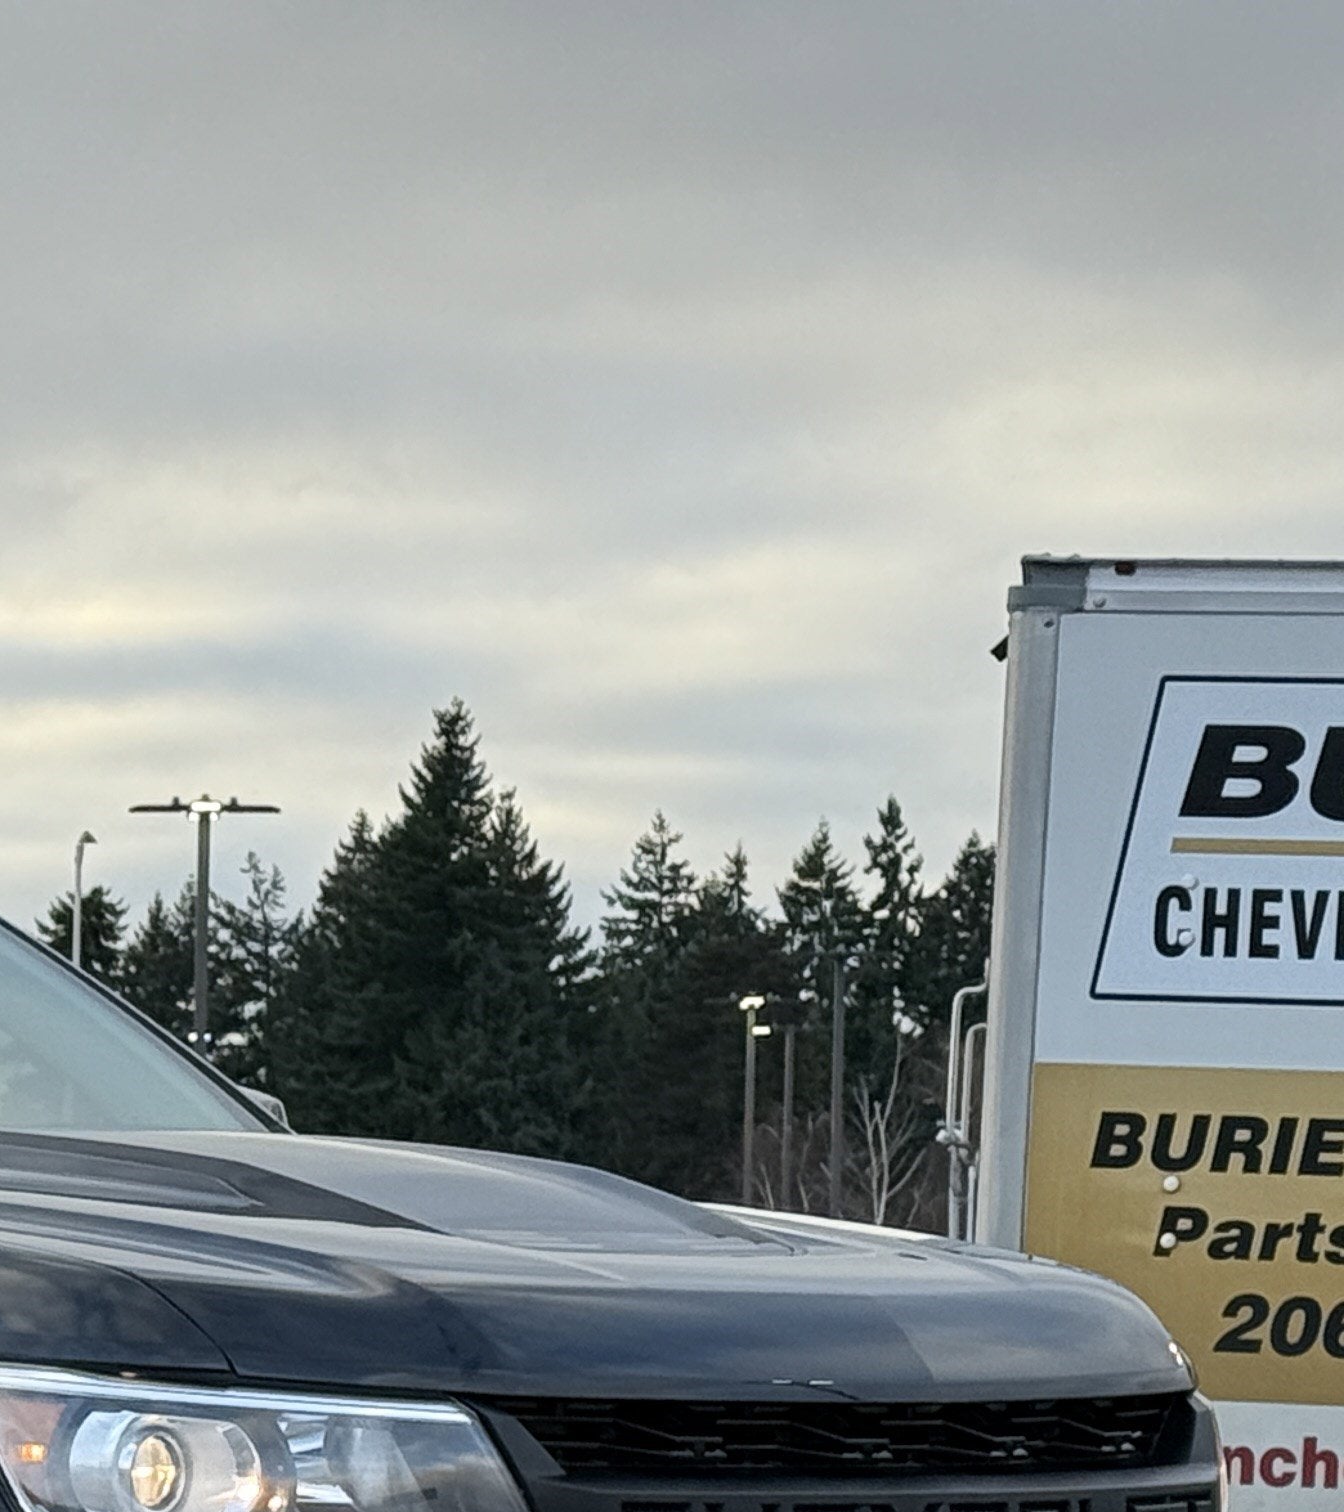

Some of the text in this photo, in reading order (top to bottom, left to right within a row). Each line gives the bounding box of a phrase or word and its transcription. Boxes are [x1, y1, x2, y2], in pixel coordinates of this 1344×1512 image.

[1179, 724, 1344, 822] B
[1154, 885, 1344, 961] CHEV
[1089, 1111, 1344, 1177] BURIE
